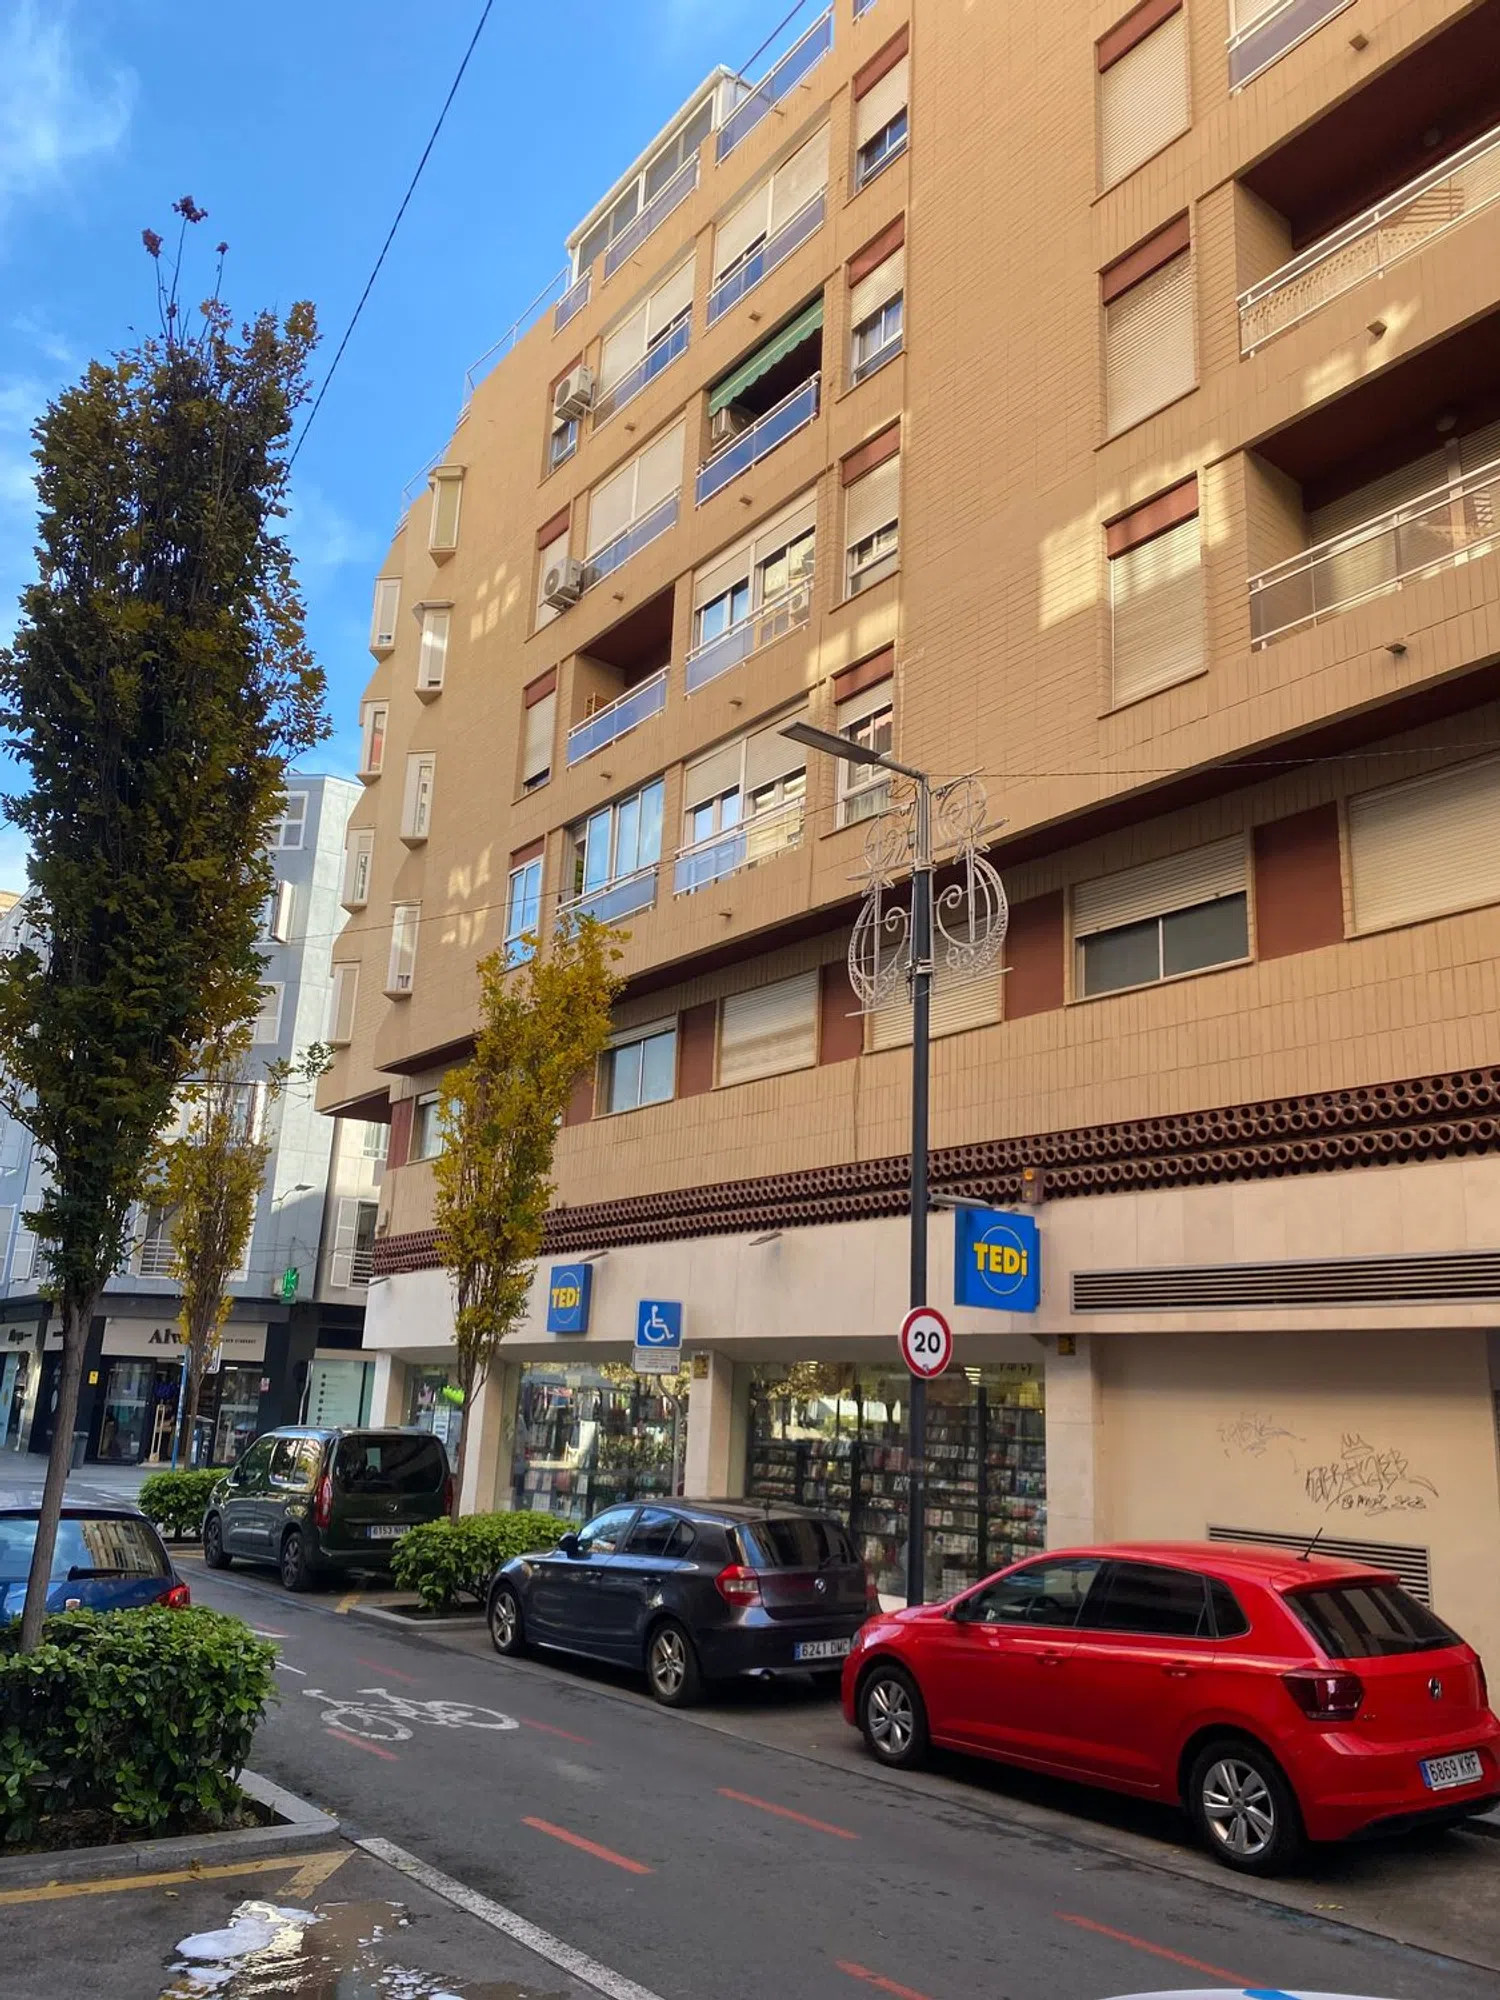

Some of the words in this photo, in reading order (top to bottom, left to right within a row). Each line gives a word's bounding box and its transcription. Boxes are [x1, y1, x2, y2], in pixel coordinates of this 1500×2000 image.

[973, 1242, 1027, 1277] TEDi
[551, 1286, 580, 1309] TEDi
[914, 1331, 940, 1354] 20
[802, 1642, 827, 1657] 6241
[1429, 1760, 1459, 1783] 6869
